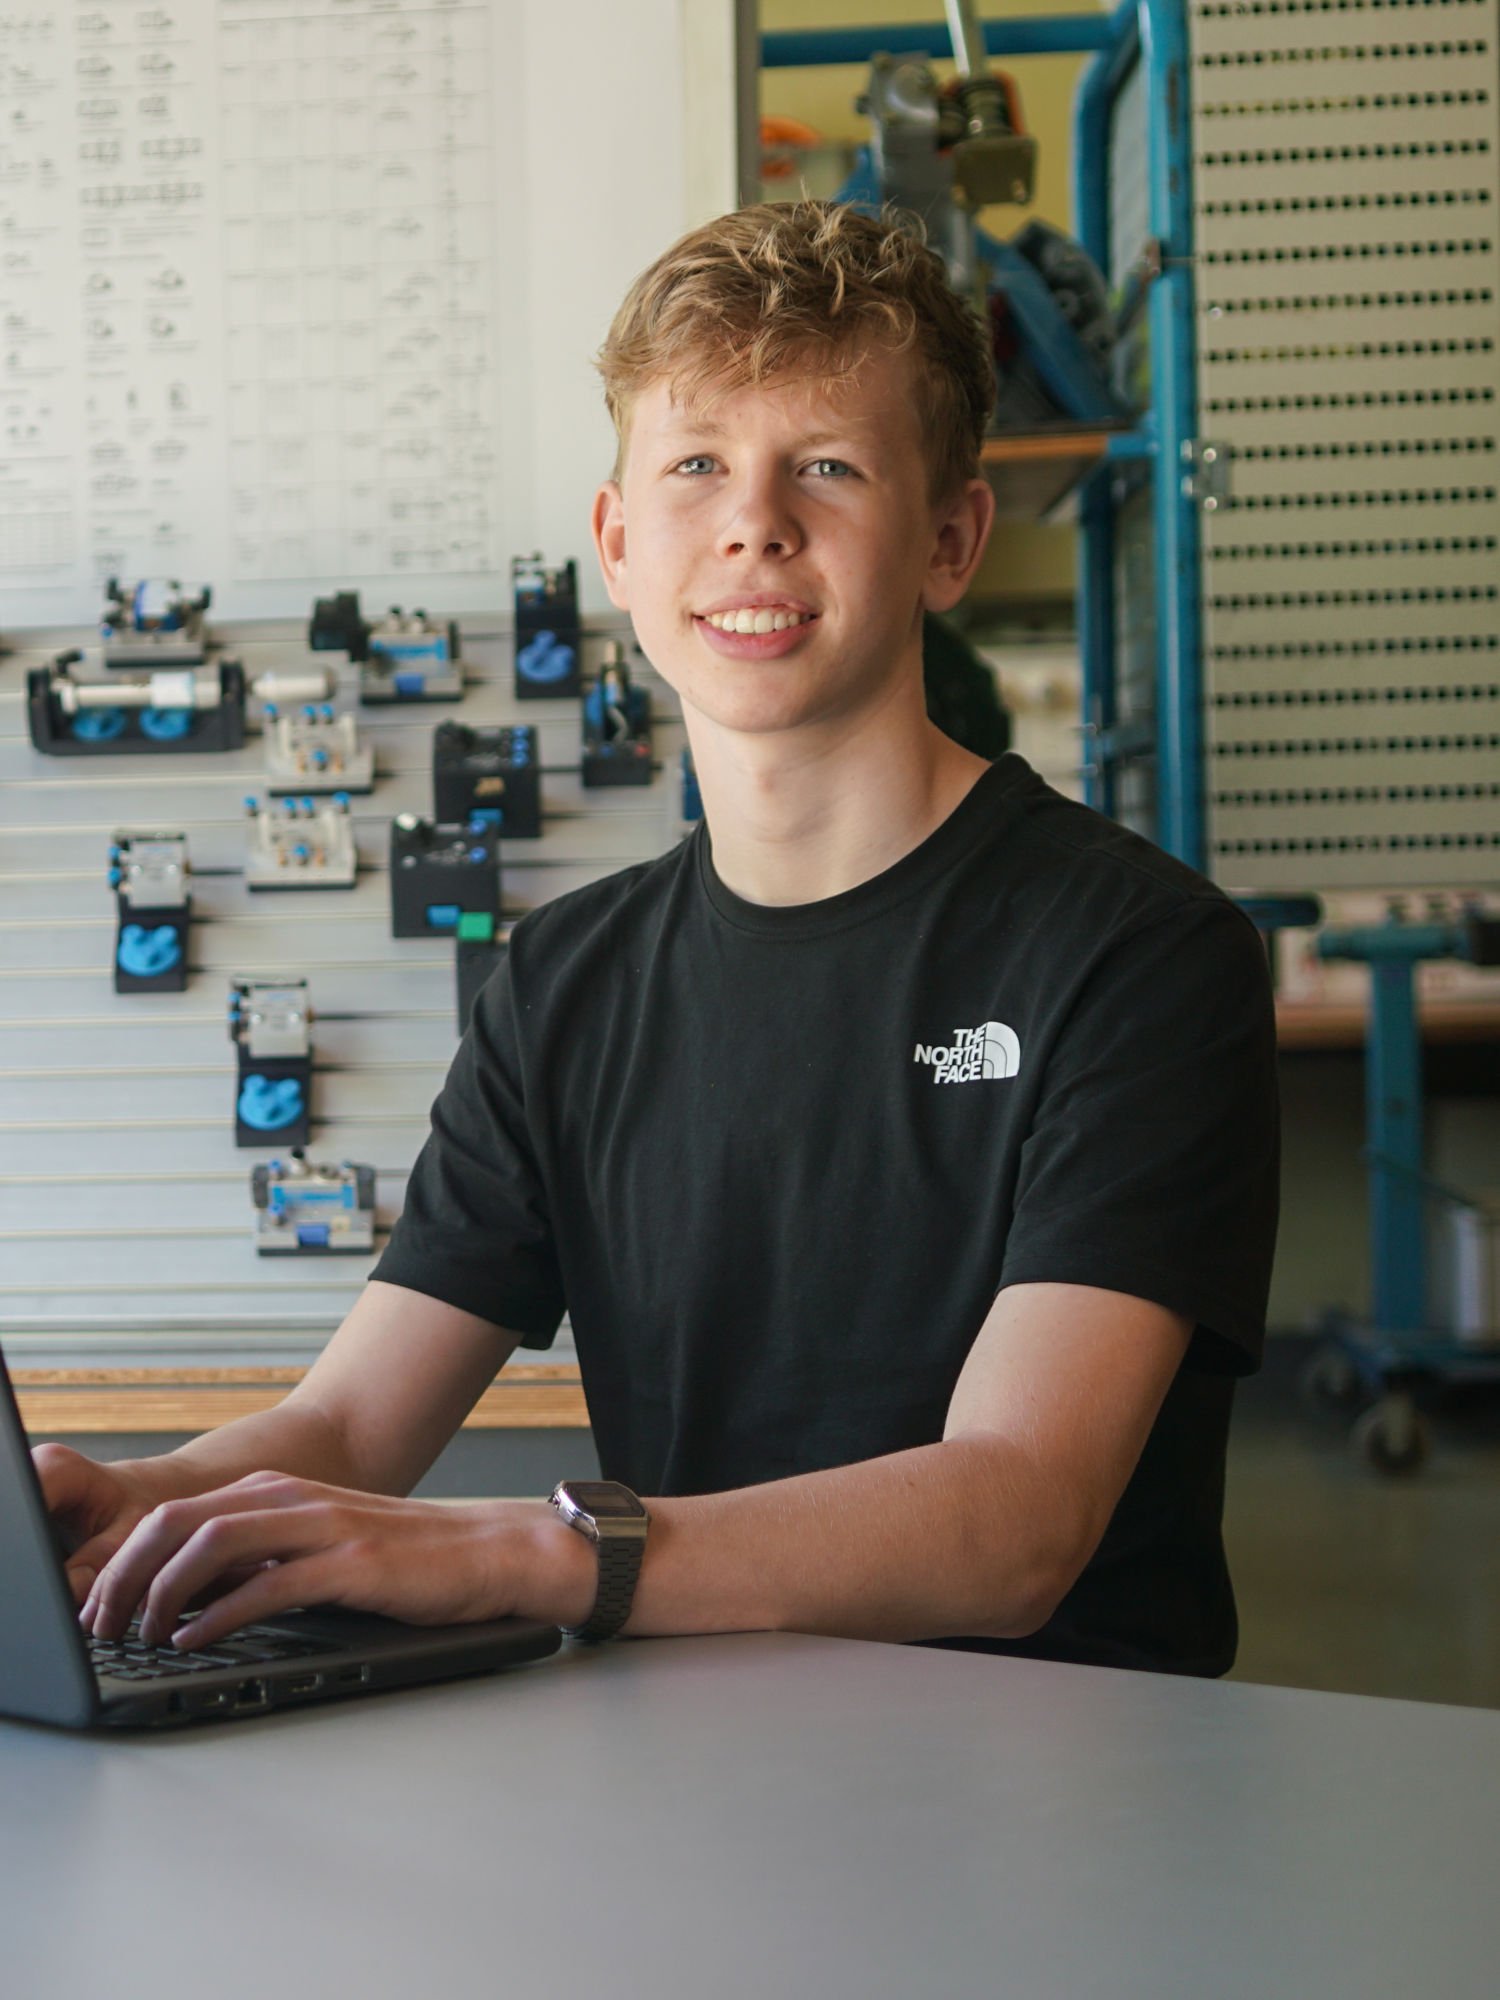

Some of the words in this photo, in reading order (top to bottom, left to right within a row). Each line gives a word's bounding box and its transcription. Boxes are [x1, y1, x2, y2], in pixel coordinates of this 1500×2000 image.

[953, 1023, 987, 1047] THE
[914, 1042, 983, 1066] NORTH
[934, 1061, 982, 1084] FACE
